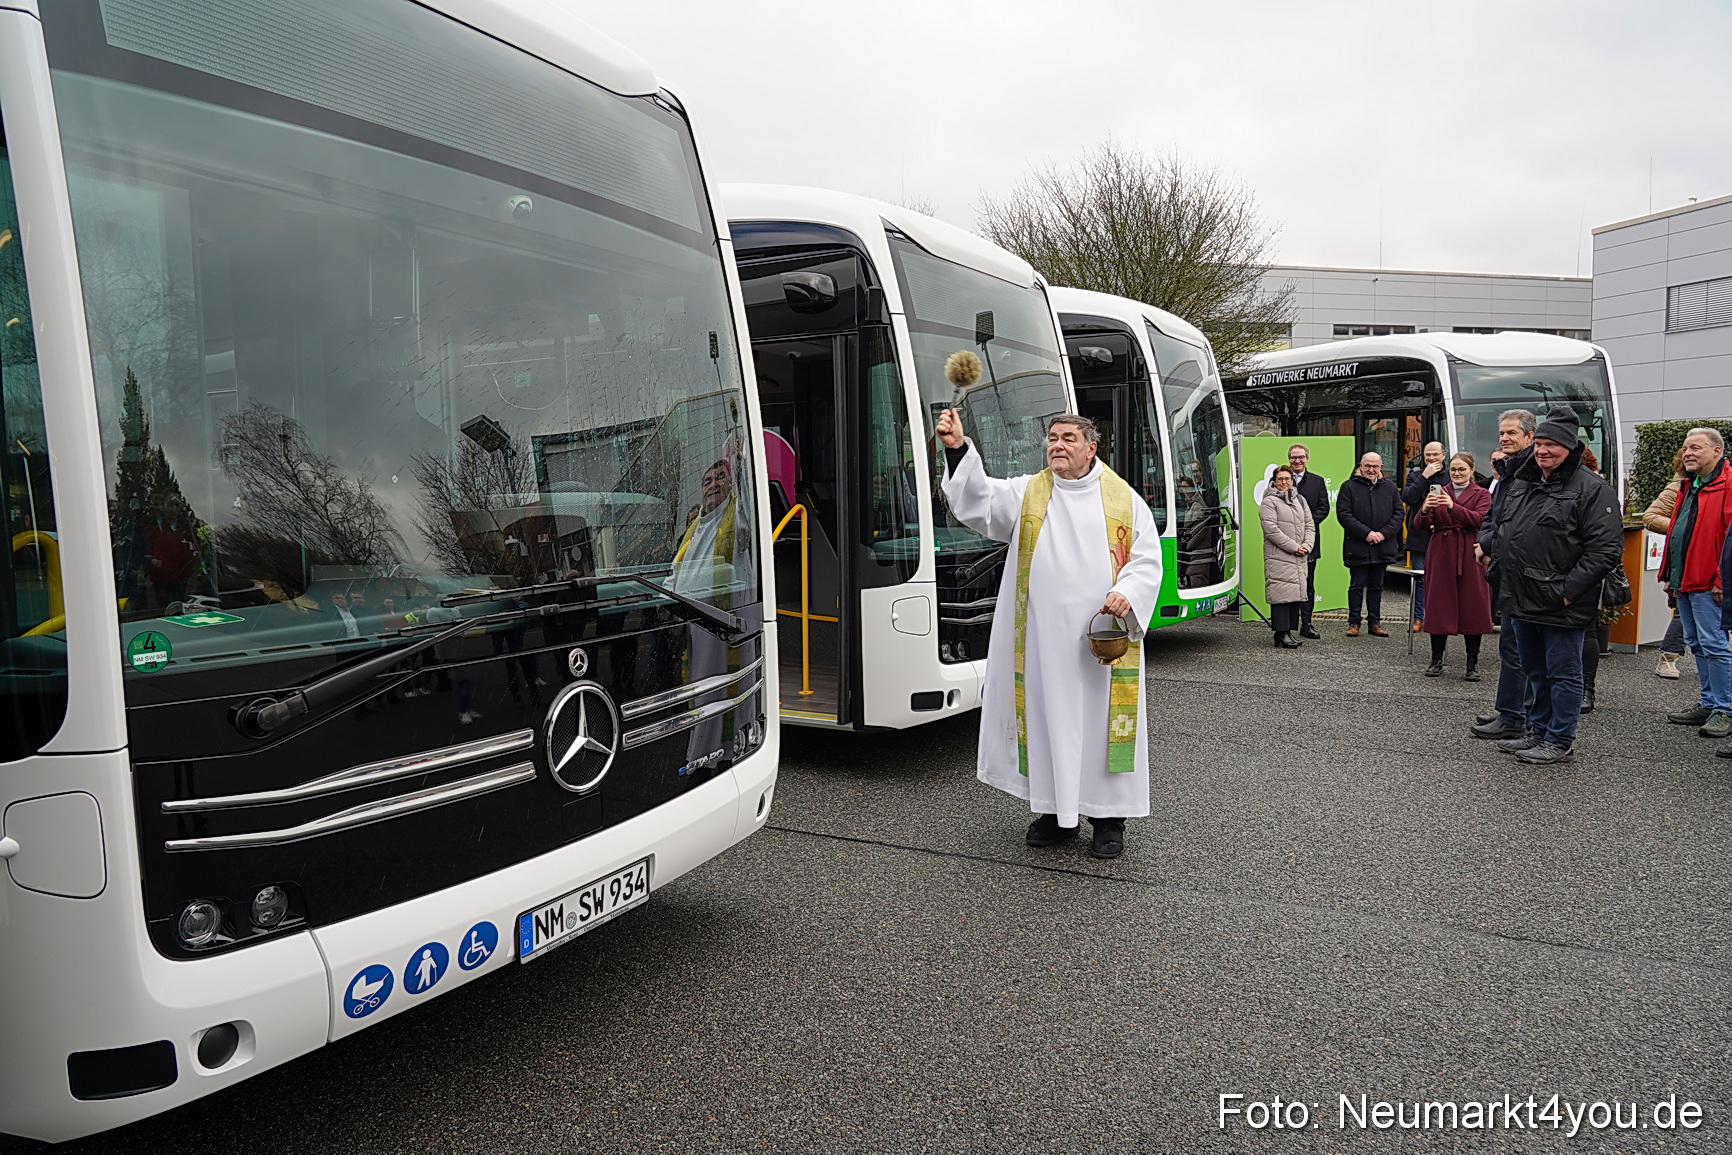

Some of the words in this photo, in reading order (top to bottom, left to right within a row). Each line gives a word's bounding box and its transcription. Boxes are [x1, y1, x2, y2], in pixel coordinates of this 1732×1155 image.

[1252, 368, 1305, 387] STADTWERKE
[1306, 362, 1359, 380] NEUMARKT
[143, 633, 157, 652] 4
[534, 902, 564, 945] NM
[578, 883, 605, 922] SW
[609, 865, 645, 908] 934
[523, 938, 530, 949] D
